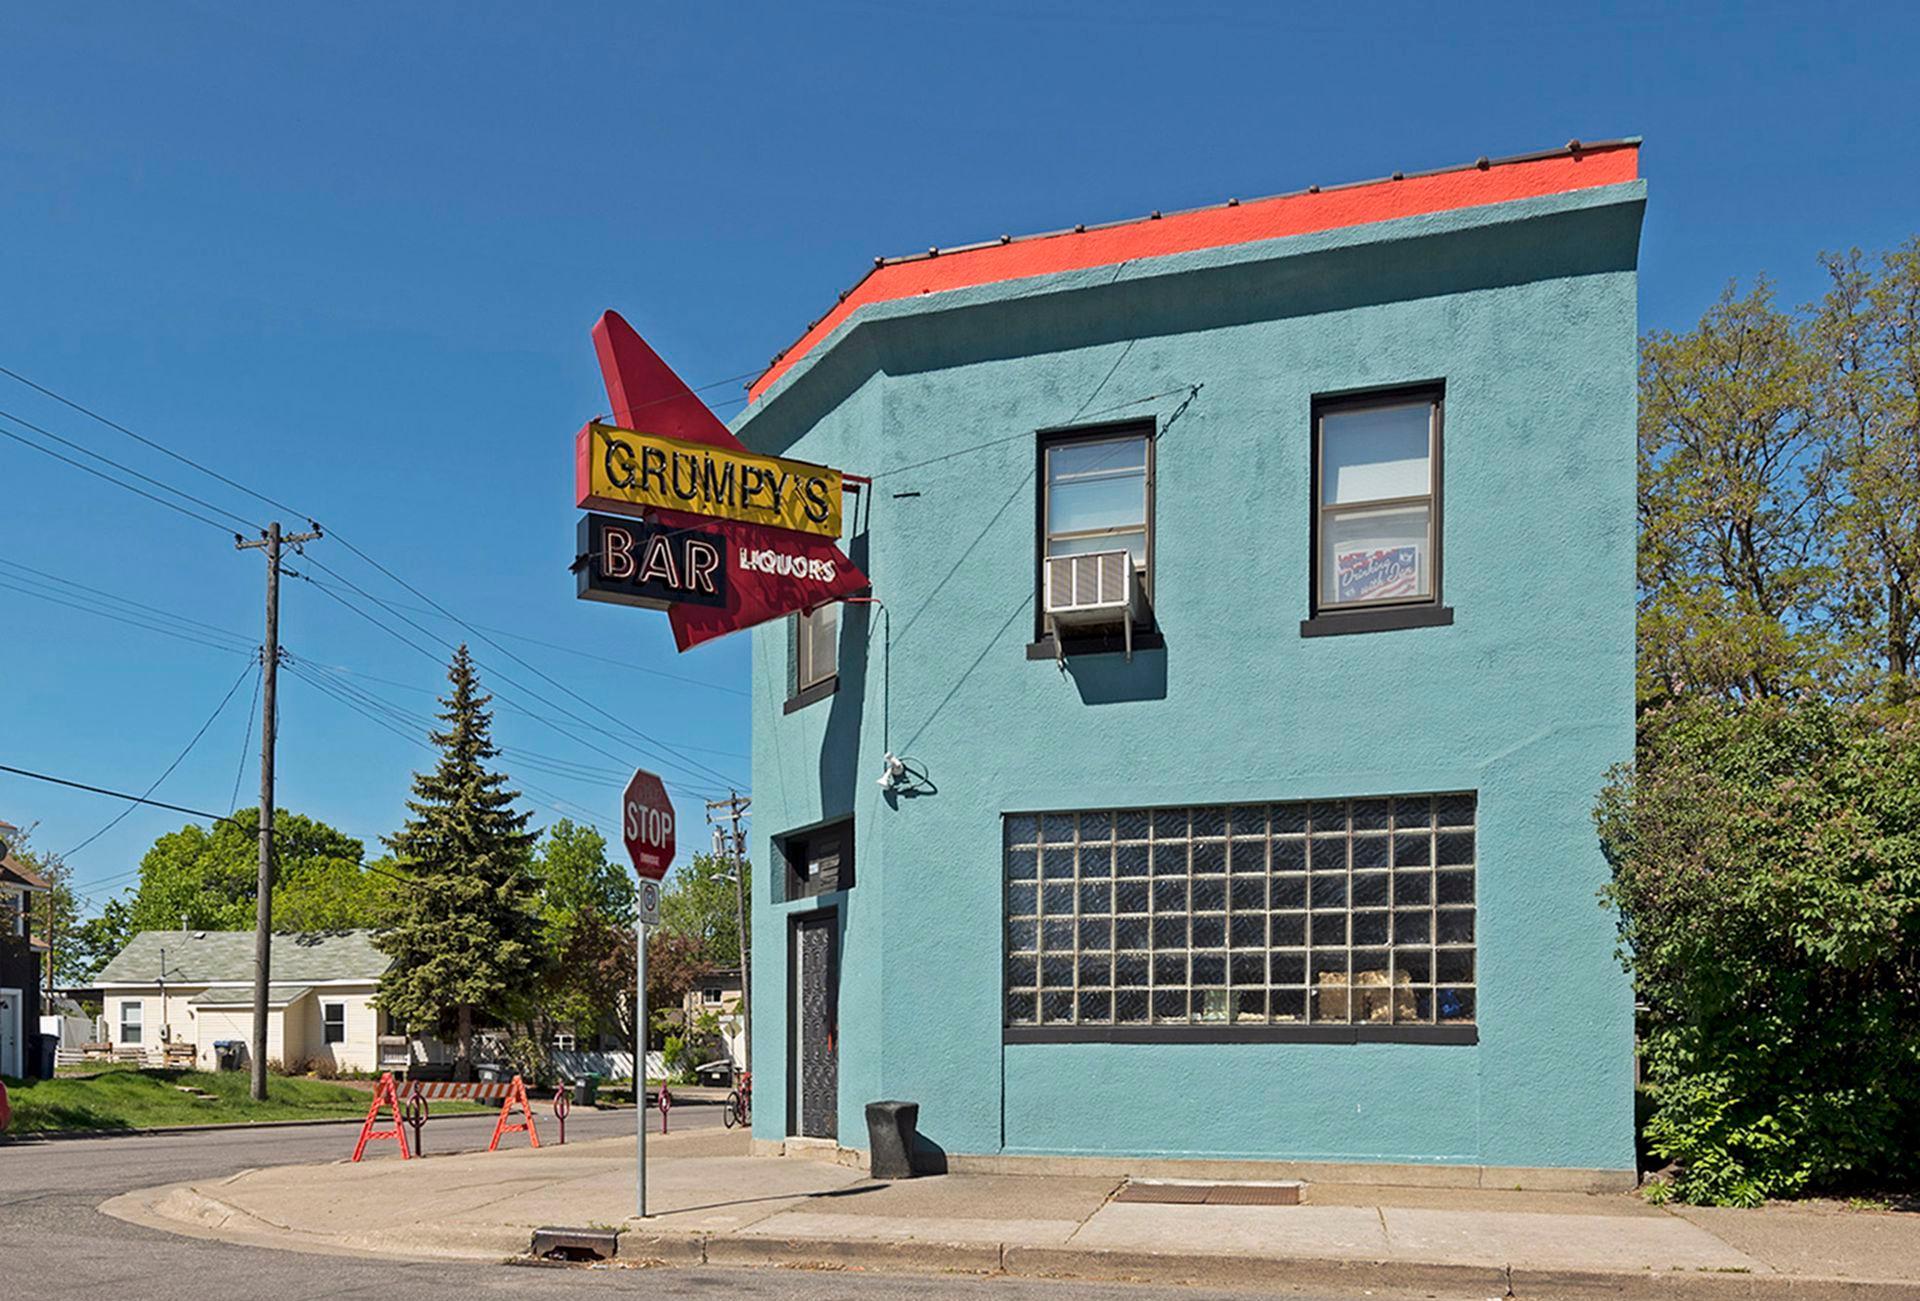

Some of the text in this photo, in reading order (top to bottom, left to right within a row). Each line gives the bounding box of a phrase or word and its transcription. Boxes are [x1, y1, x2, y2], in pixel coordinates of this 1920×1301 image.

[604, 438, 830, 524] GRUMPY'S
[602, 527, 719, 594] BAR
[739, 547, 836, 583] LIQUORS
[1342, 557, 1391, 587] Drinking
[627, 801, 673, 849] STOP
